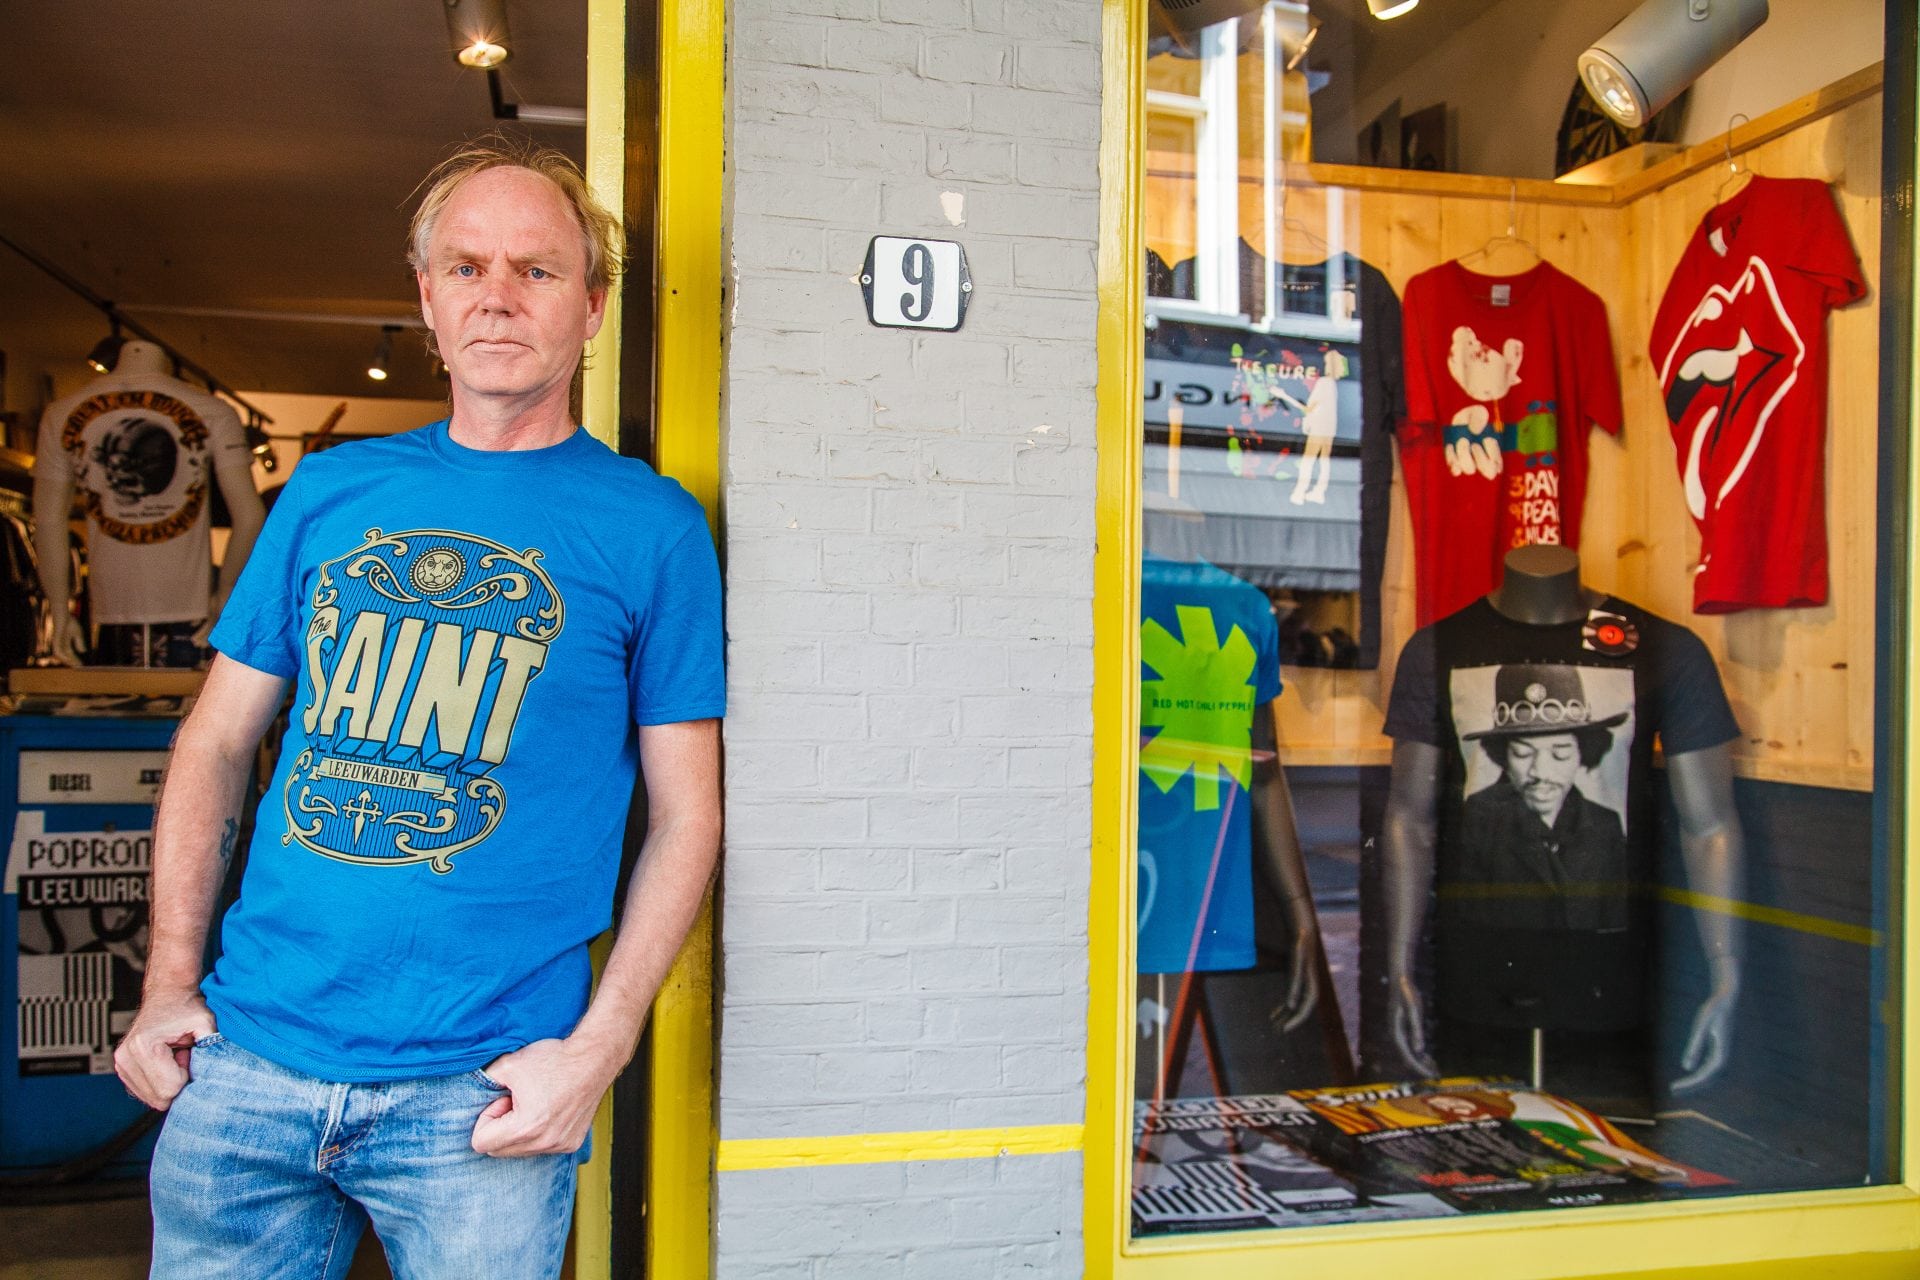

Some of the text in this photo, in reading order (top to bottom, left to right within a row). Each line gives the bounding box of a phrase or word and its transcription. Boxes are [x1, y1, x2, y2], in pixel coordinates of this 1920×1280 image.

[900, 243, 935, 322] 9
[1230, 357, 1317, 380] THE CURE
[1509, 470, 1560, 499] 3 DAY
[1522, 499, 1561, 525] PEA
[1524, 525, 1562, 546] MUS
[311, 617, 332, 637] The
[304, 606, 549, 765] SAINT
[1152, 698, 1172, 709] RED
[1176, 699, 1194, 709] HOT
[49, 773, 92, 792] DIESEL
[328, 759, 421, 789] LEEUWARDEN
[28, 838, 151, 869] POPRON
[27, 877, 151, 906] LEEUWAR
